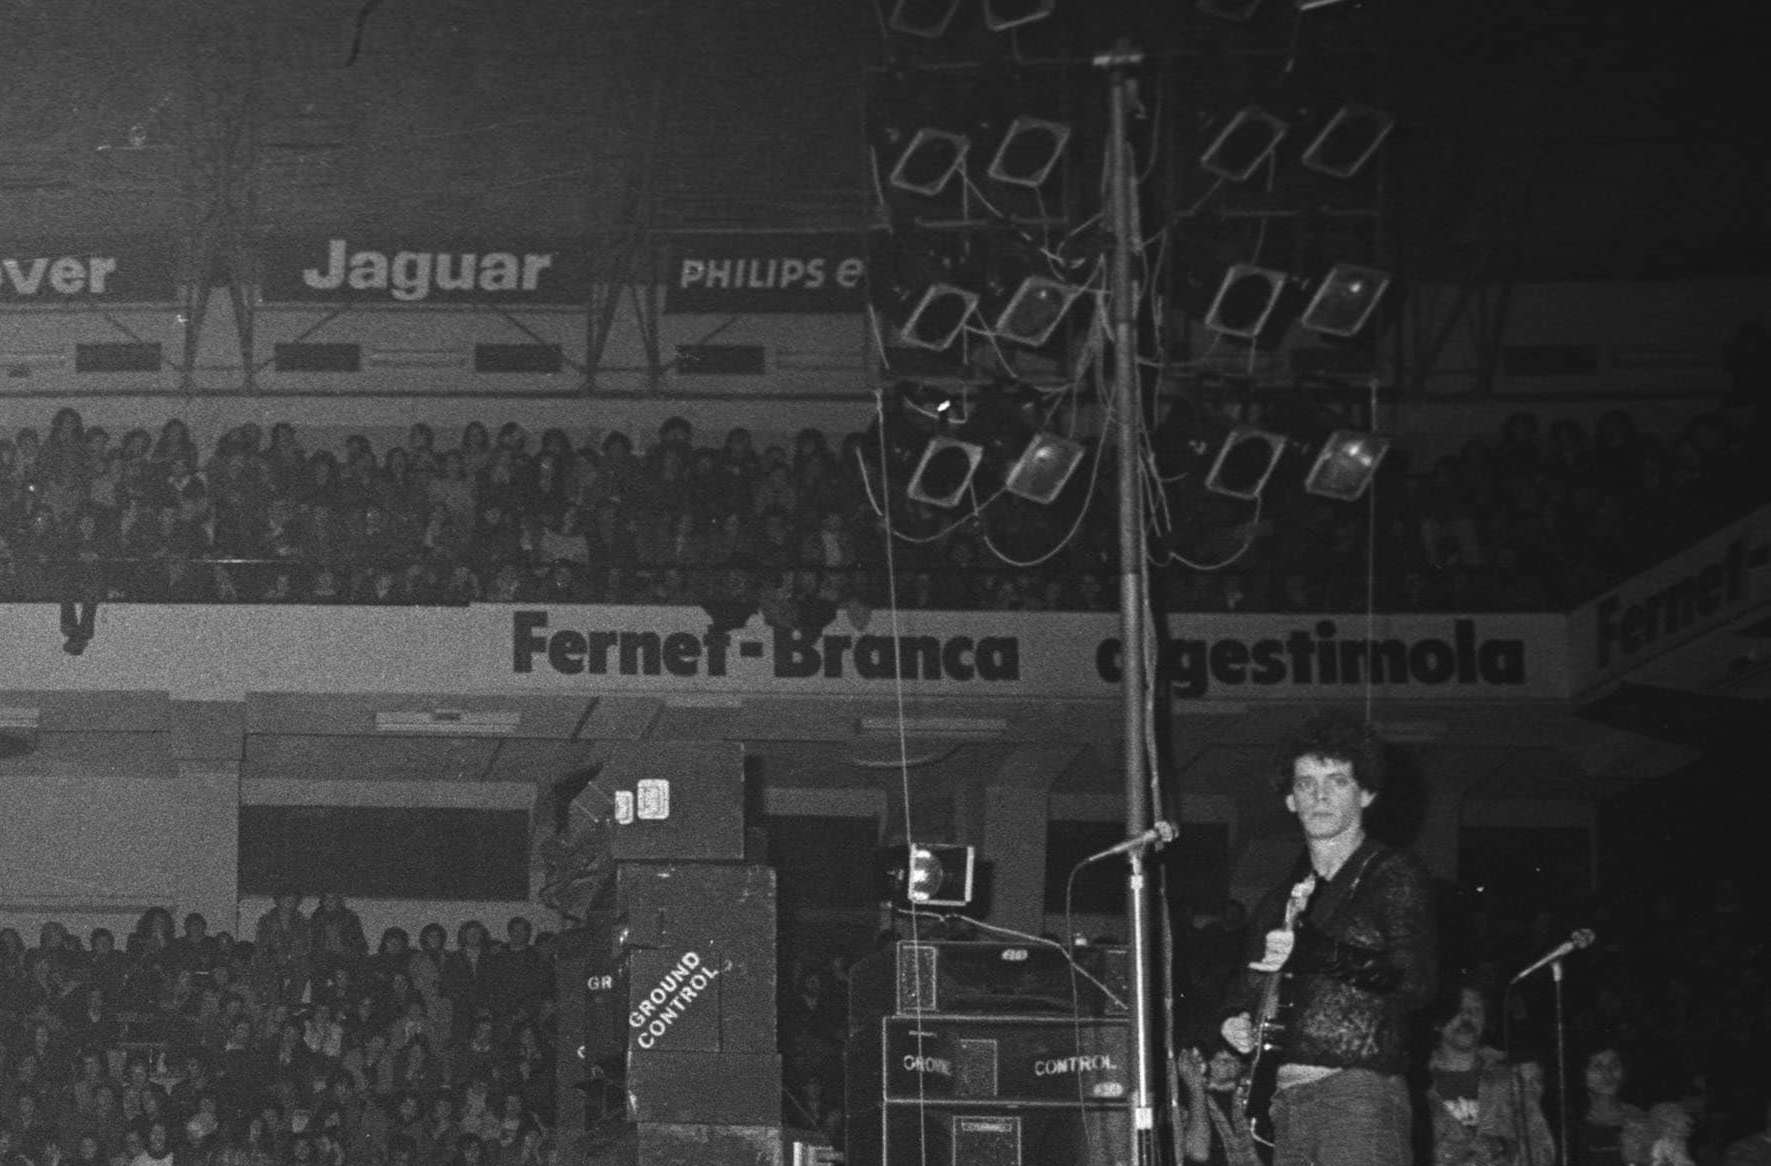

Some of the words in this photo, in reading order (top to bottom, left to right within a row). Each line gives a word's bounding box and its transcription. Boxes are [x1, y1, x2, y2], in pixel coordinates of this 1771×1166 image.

[303, 239, 553, 300] Jaguar
[681, 258, 825, 289] PHILIPS
[513, 610, 1019, 682] Fernet-Branca
[1095, 618, 1526, 699] gestimola
[629, 951, 700, 1028] GROUND
[637, 966, 719, 1049] CONTROL
[1034, 1055, 1118, 1077] CONTROL
